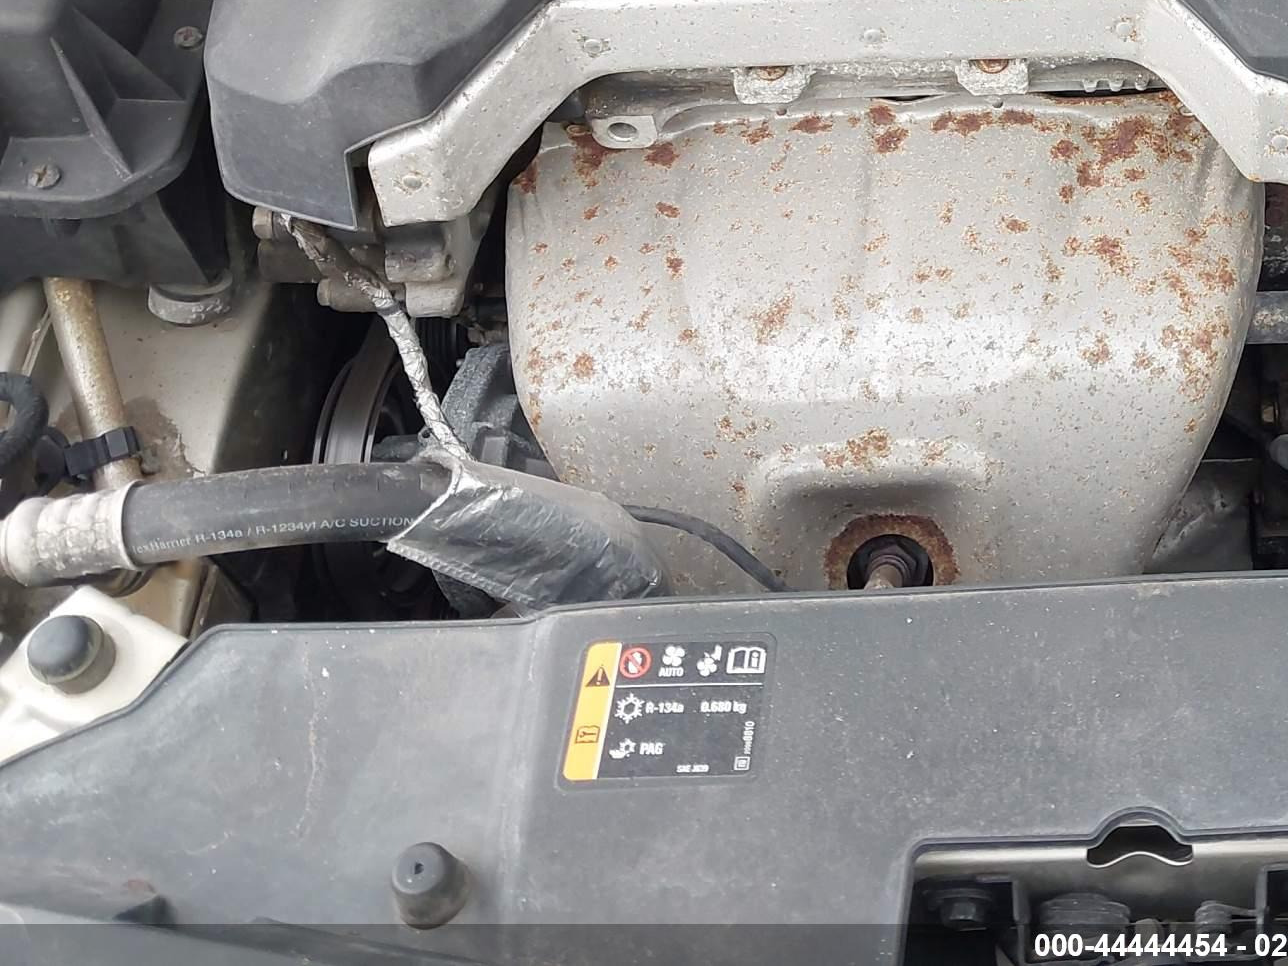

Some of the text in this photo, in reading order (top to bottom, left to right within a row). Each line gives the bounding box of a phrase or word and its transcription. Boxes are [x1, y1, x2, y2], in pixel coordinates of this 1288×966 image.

[195, 529, 243, 543] R-134a
[320, 518, 346, 530] A/C
[349, 517, 415, 528] SUCTION
[658, 667, 684, 677] AUTO
[645, 701, 684, 714] R-134a
[733, 700, 748, 715] kg
[639, 742, 664, 755] PAG
